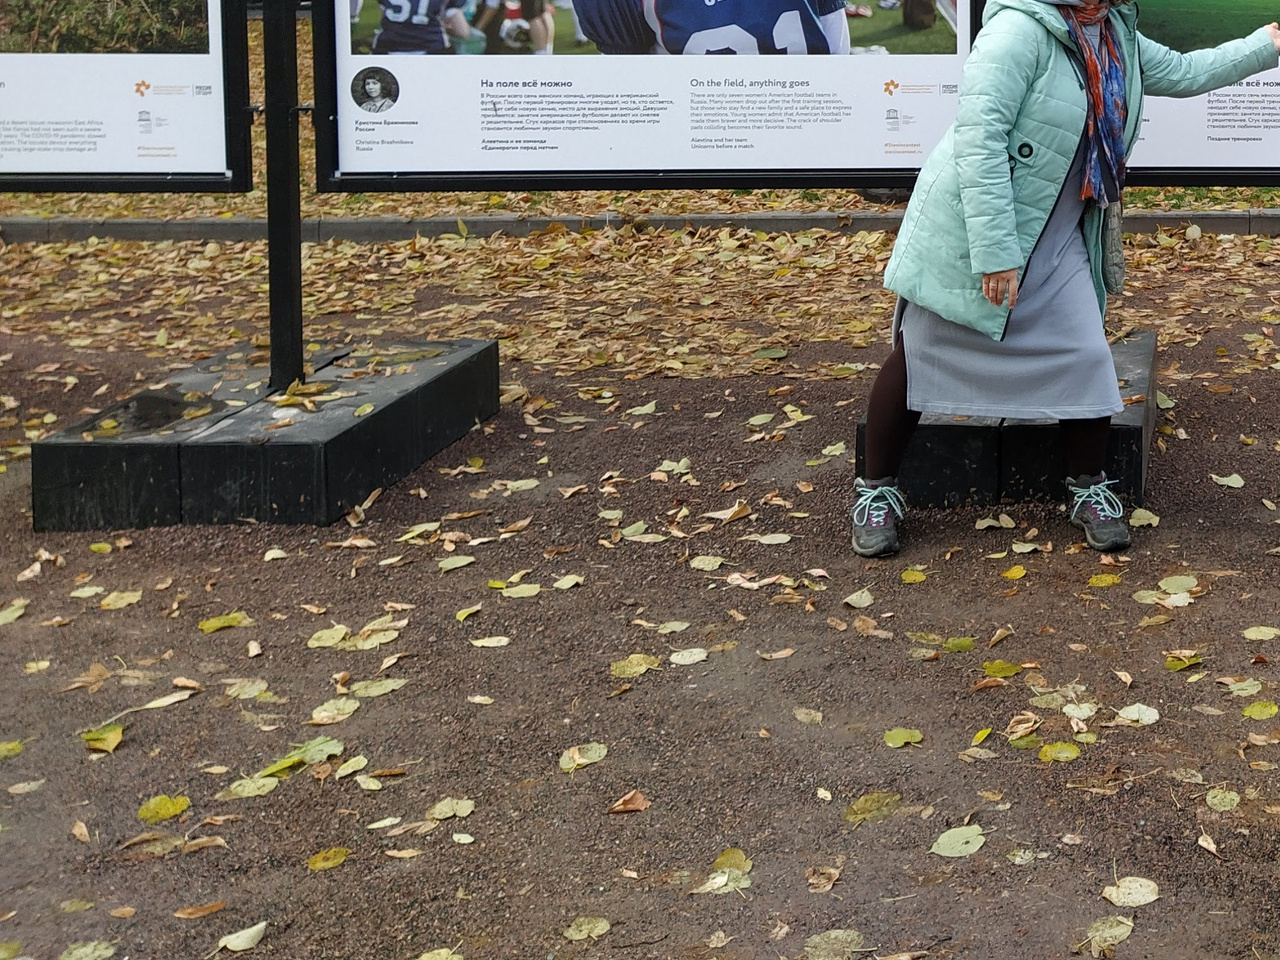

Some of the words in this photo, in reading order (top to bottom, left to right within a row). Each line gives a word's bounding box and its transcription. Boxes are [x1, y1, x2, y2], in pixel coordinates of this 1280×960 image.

[480, 80, 494, 88] На
[521, 80, 538, 88] всё
[690, 78, 705, 87] On
[706, 78, 722, 87] the
[723, 78, 747, 89] field,
[748, 78, 787, 89] anything
[789, 81, 810, 89] goes
[708, 98, 724, 106] Many
[744, 98, 757, 106] drop
[801, 98, 822, 106] training
[822, 98, 843, 106] session,
[728, 104, 739, 112] stay
[767, 104, 783, 112] family
[810, 104, 824, 112] place
[1207, 135, 1230, 143] Поздние
